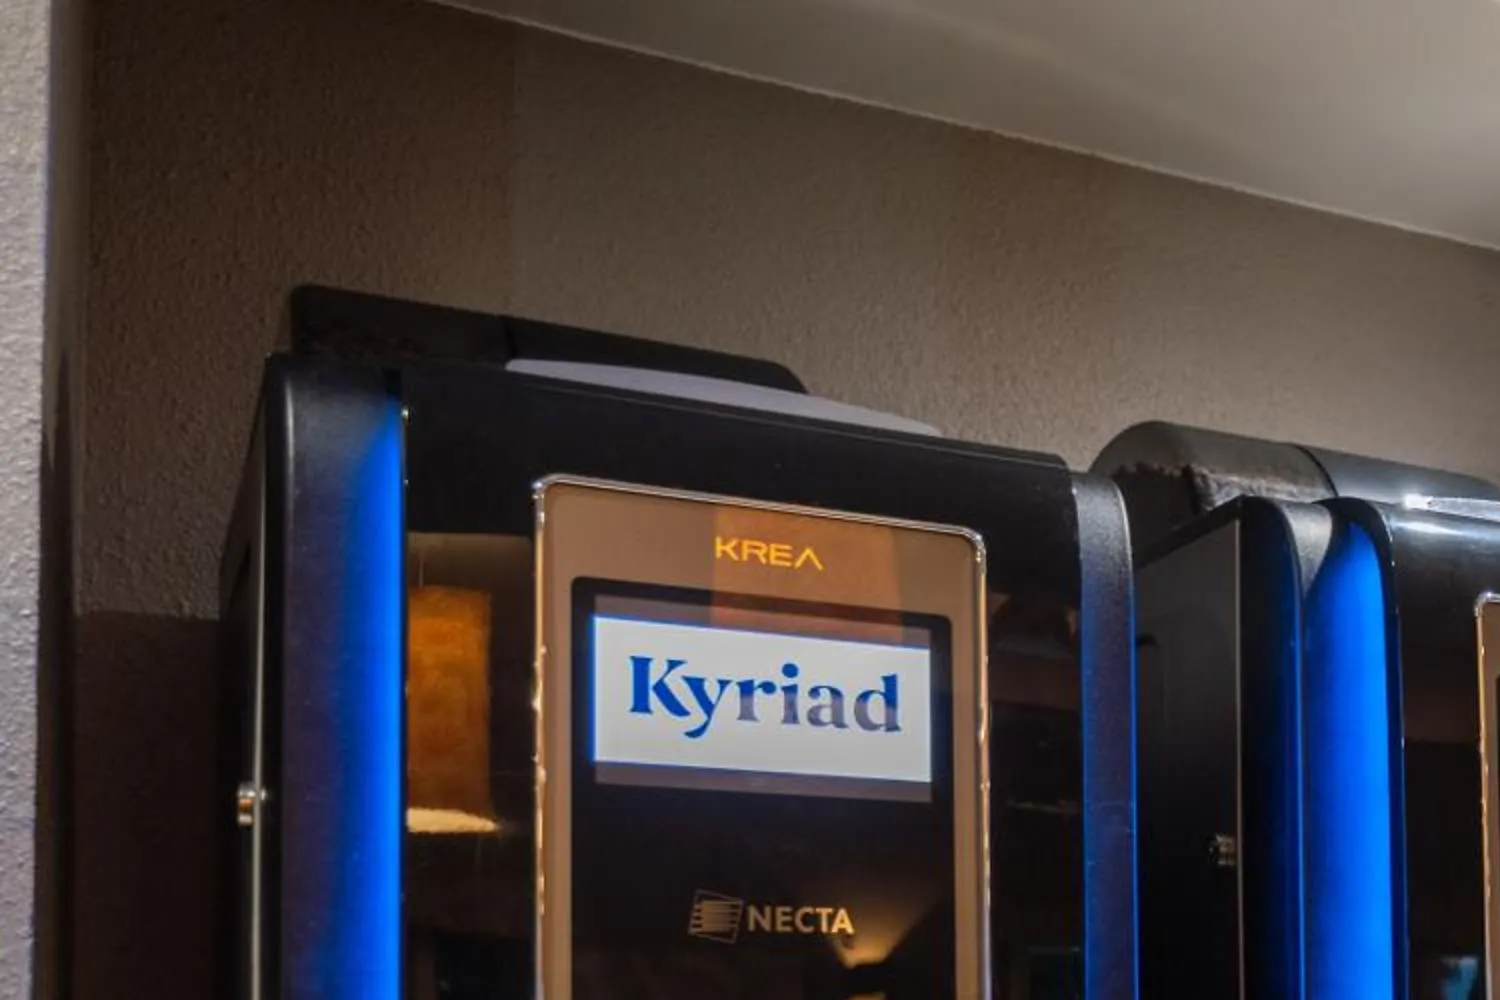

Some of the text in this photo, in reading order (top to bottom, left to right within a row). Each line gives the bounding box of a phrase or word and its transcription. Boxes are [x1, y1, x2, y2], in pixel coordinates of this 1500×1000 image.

[714, 535, 824, 571] KREA
[628, 655, 903, 739] Kyriad
[747, 905, 856, 936] NECTA
